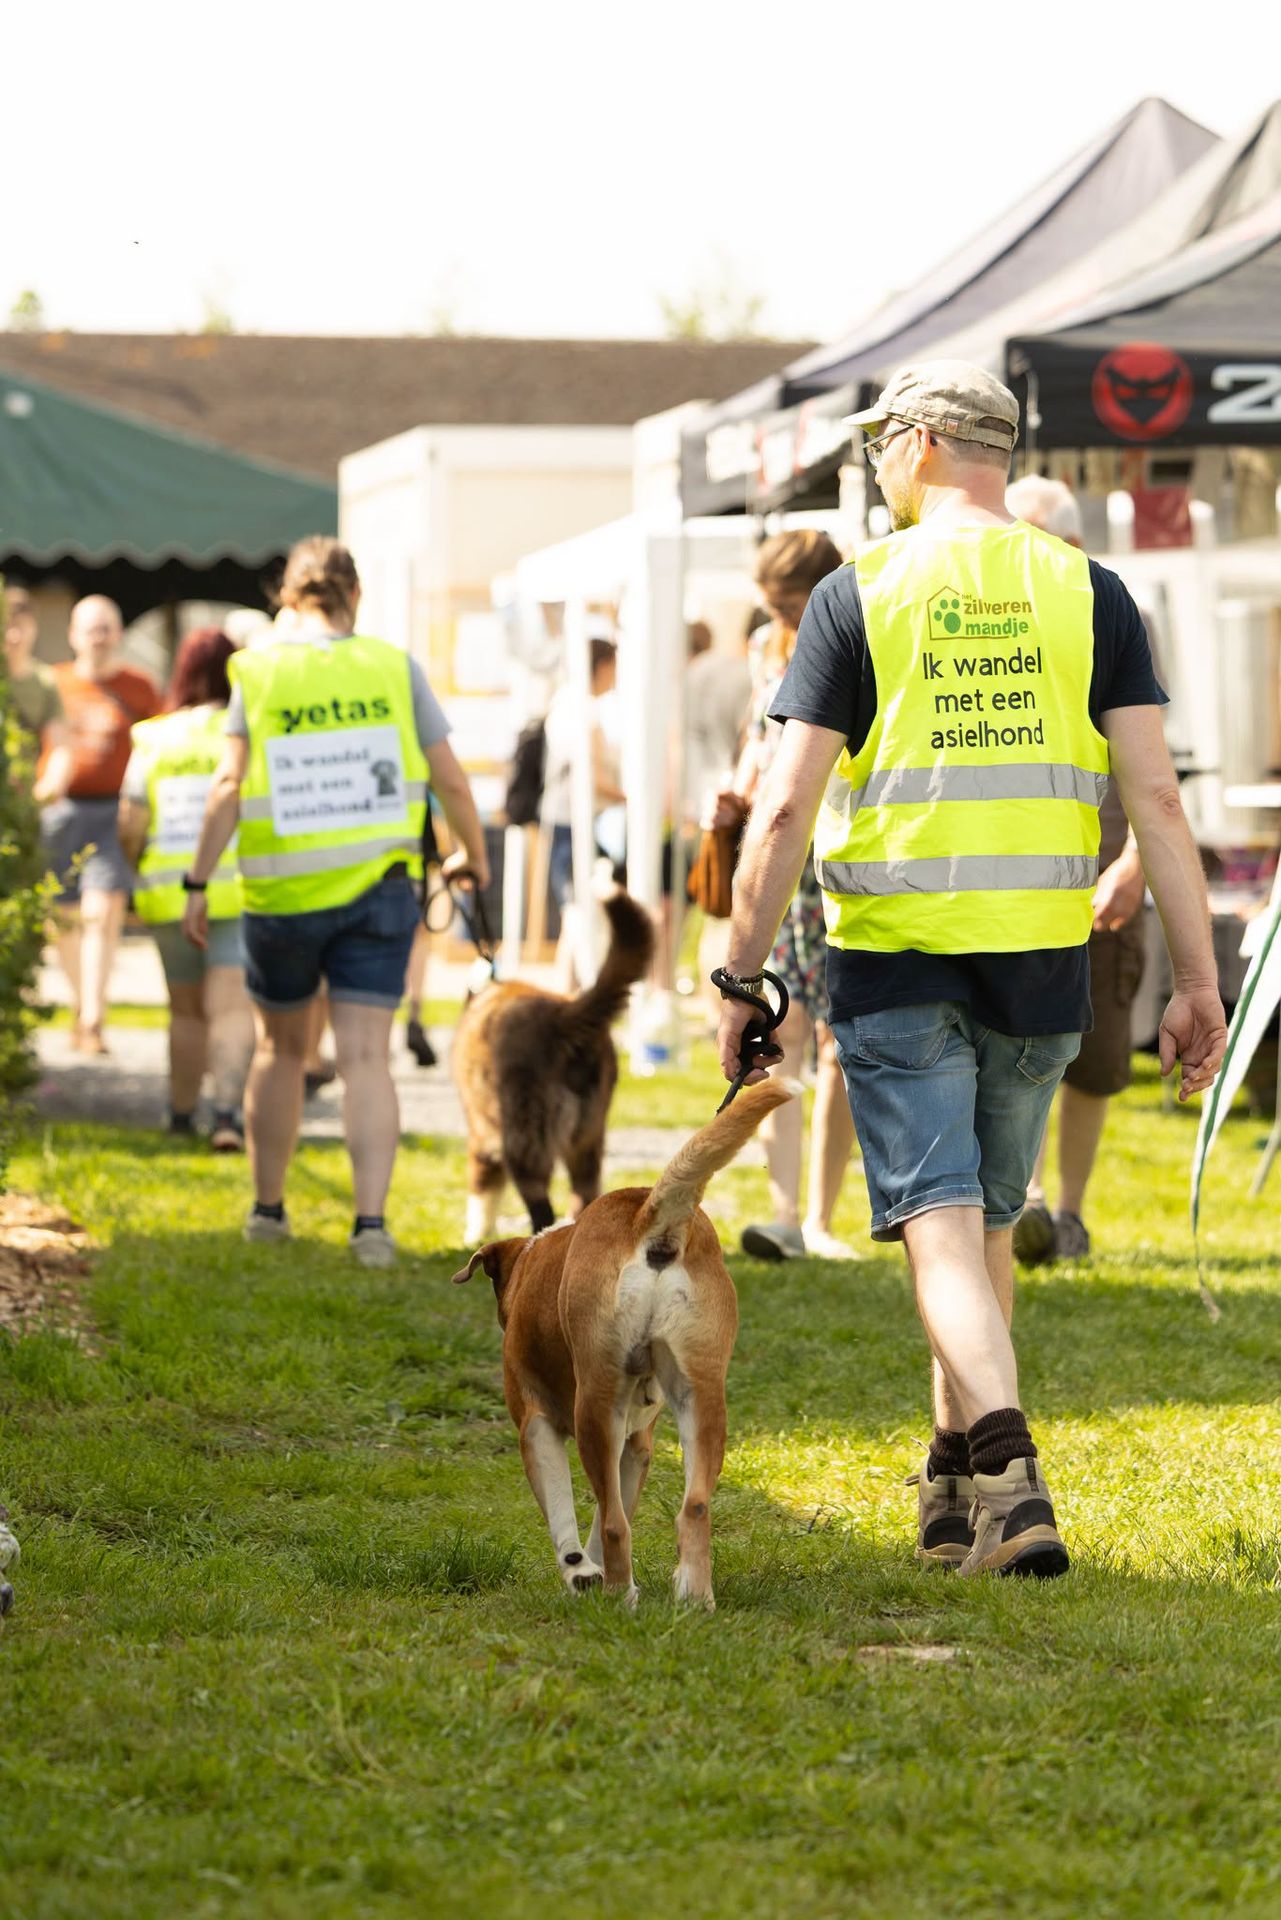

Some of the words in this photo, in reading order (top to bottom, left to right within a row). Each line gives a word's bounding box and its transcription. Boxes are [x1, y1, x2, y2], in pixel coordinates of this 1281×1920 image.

[964, 599, 1032, 615] zilveren
[965, 618, 1029, 637] mandje
[923, 652, 944, 679] Ik
[953, 646, 1042, 677] wandel
[935, 689, 984, 713] met
[992, 690, 1035, 711] een
[931, 718, 1044, 749] asielhond
